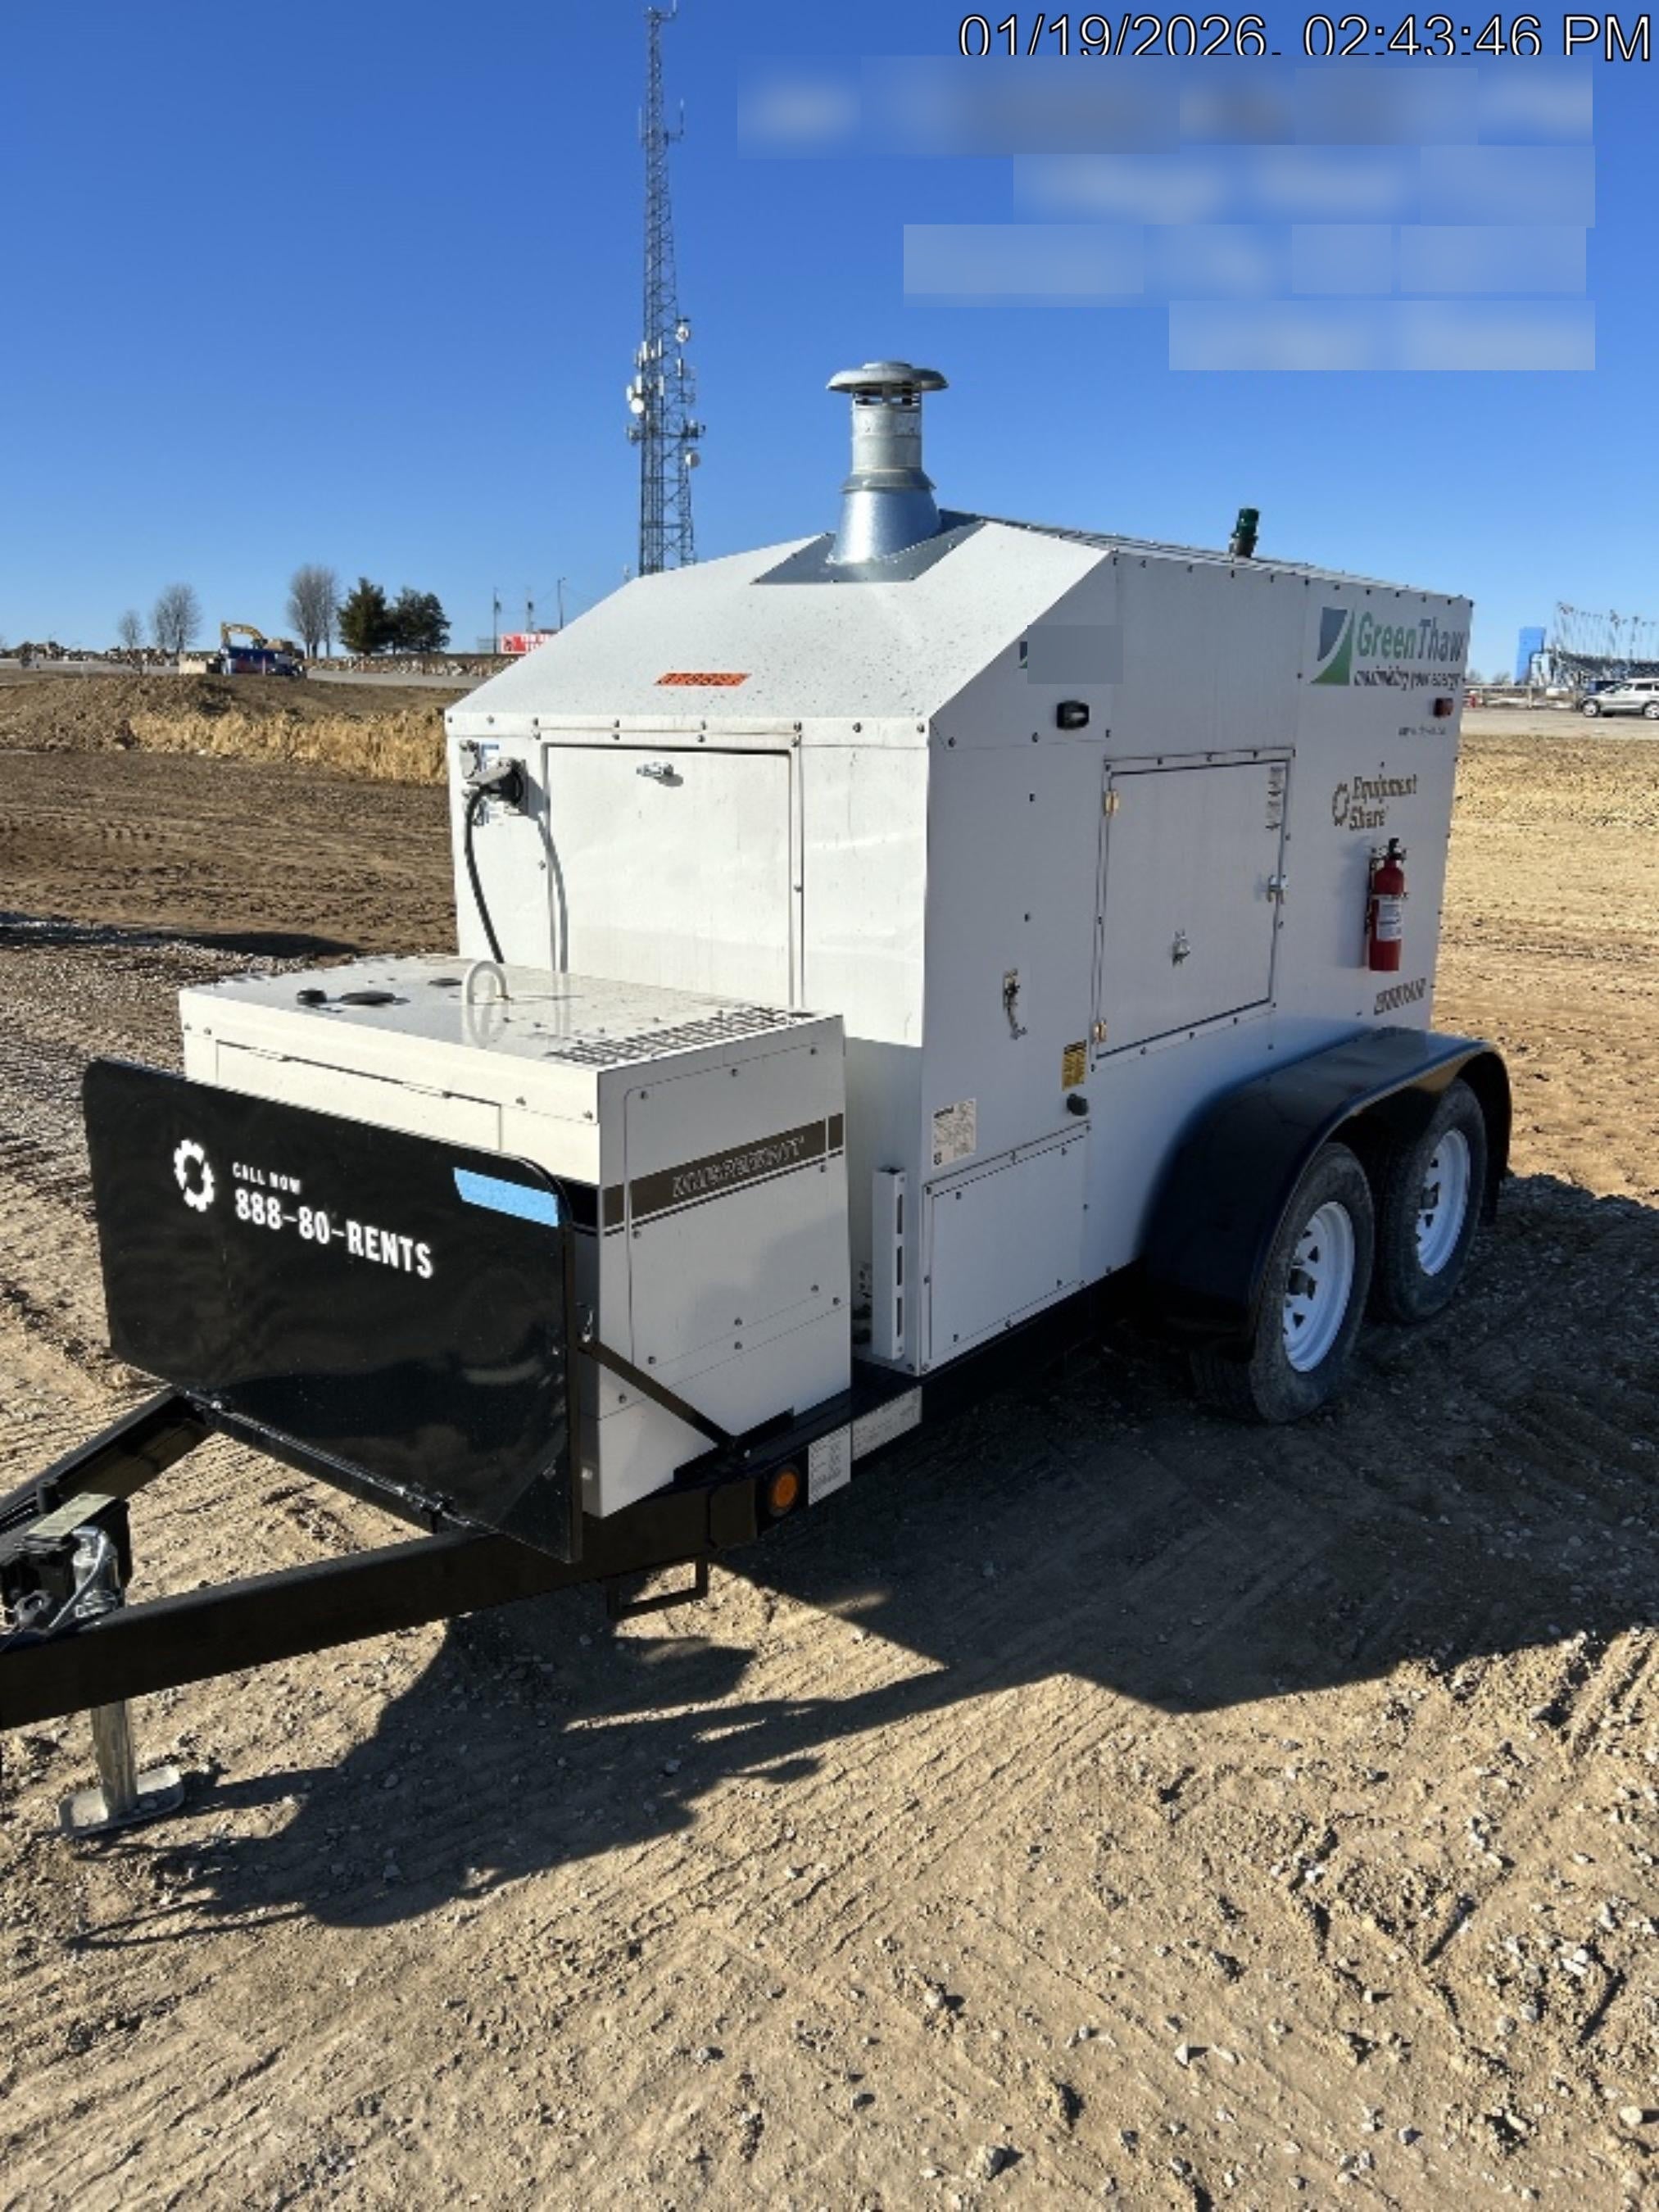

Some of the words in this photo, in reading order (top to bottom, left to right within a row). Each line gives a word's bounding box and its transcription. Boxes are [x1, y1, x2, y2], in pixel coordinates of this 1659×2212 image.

[232, 1161, 265, 1185] CALL
[270, 1171, 301, 1195] NOW
[234, 1187, 433, 1280] 888-80-RENTS
